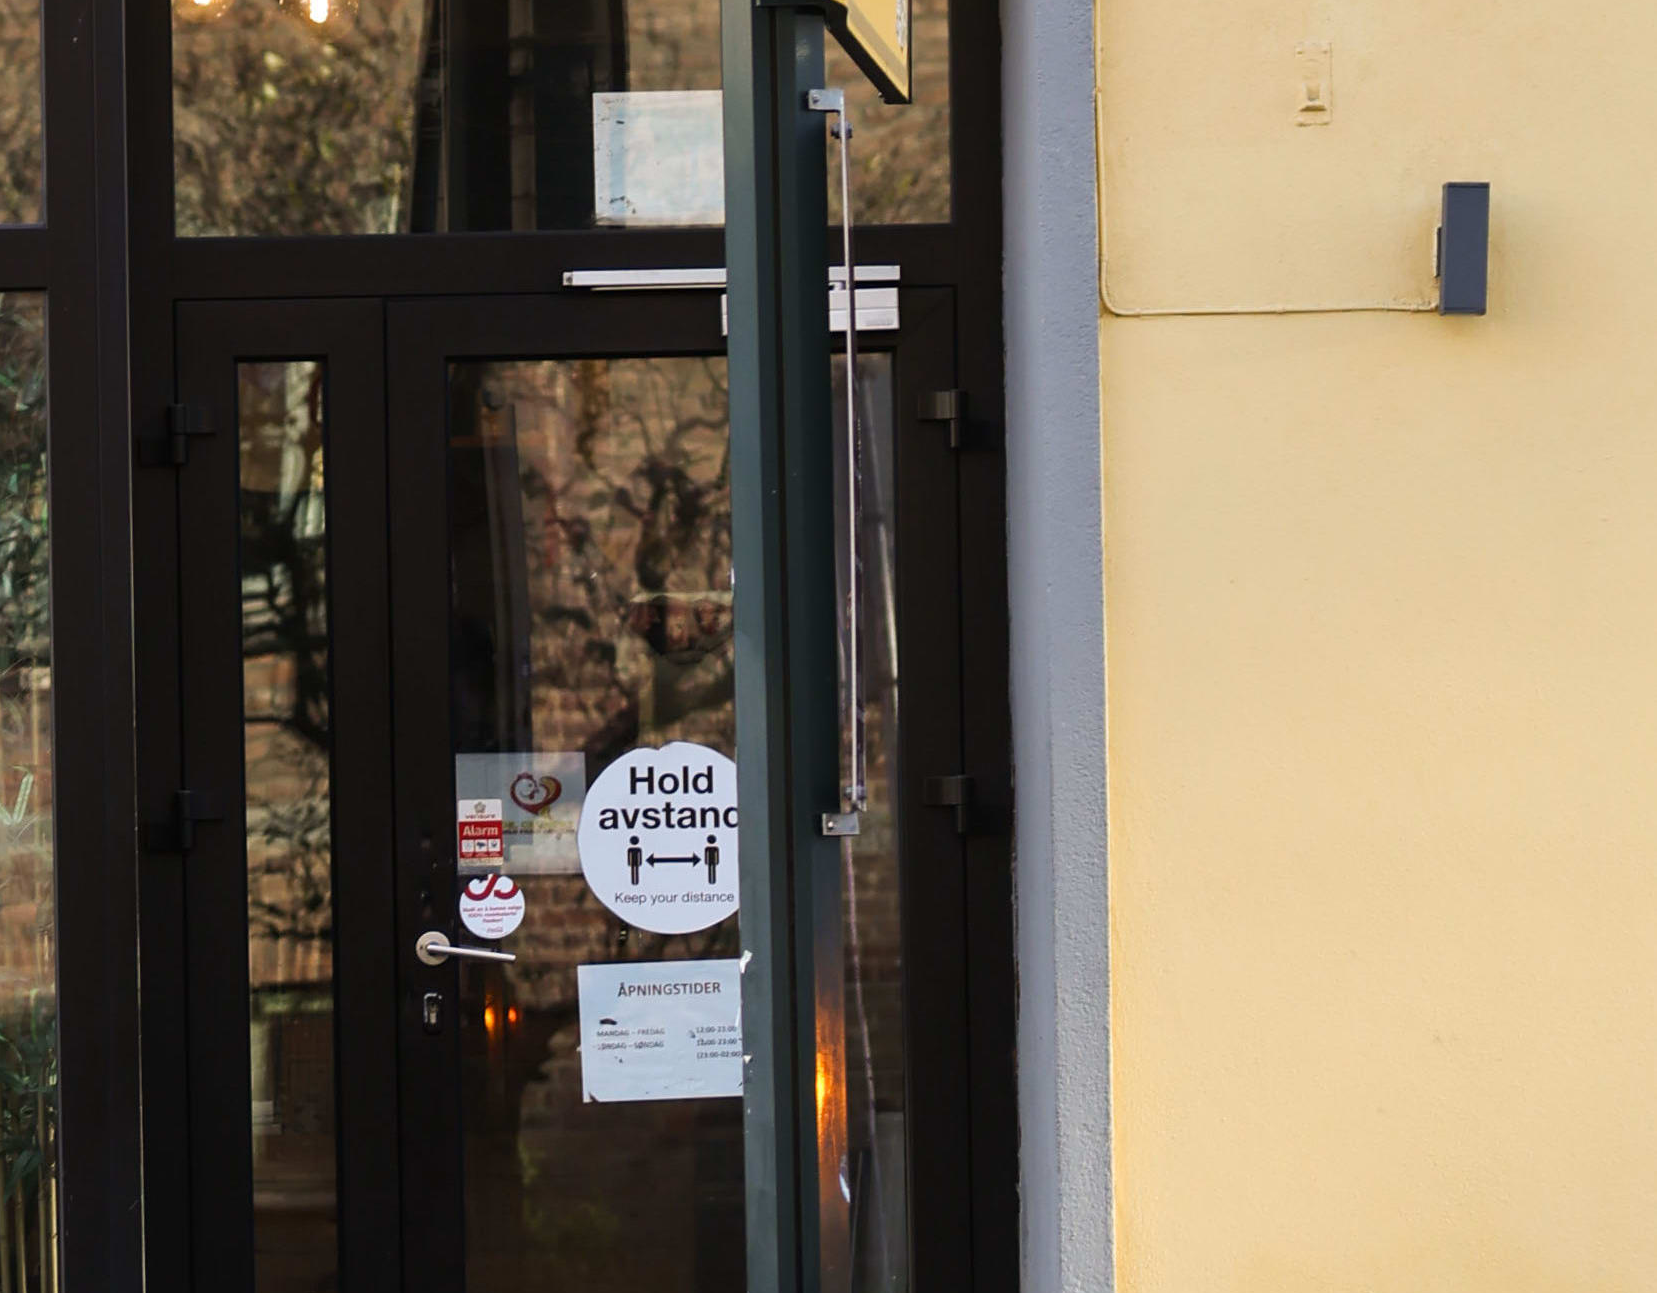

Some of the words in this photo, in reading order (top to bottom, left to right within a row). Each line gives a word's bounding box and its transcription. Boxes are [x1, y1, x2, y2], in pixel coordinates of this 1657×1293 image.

[630, 765, 714, 795] Hold
[463, 825, 499, 836] Alarm
[614, 892, 647, 904] Keep
[650, 894, 678, 905] your
[681, 892, 735, 903] distance
[617, 981, 722, 997] ÅPNINGSTIDER
